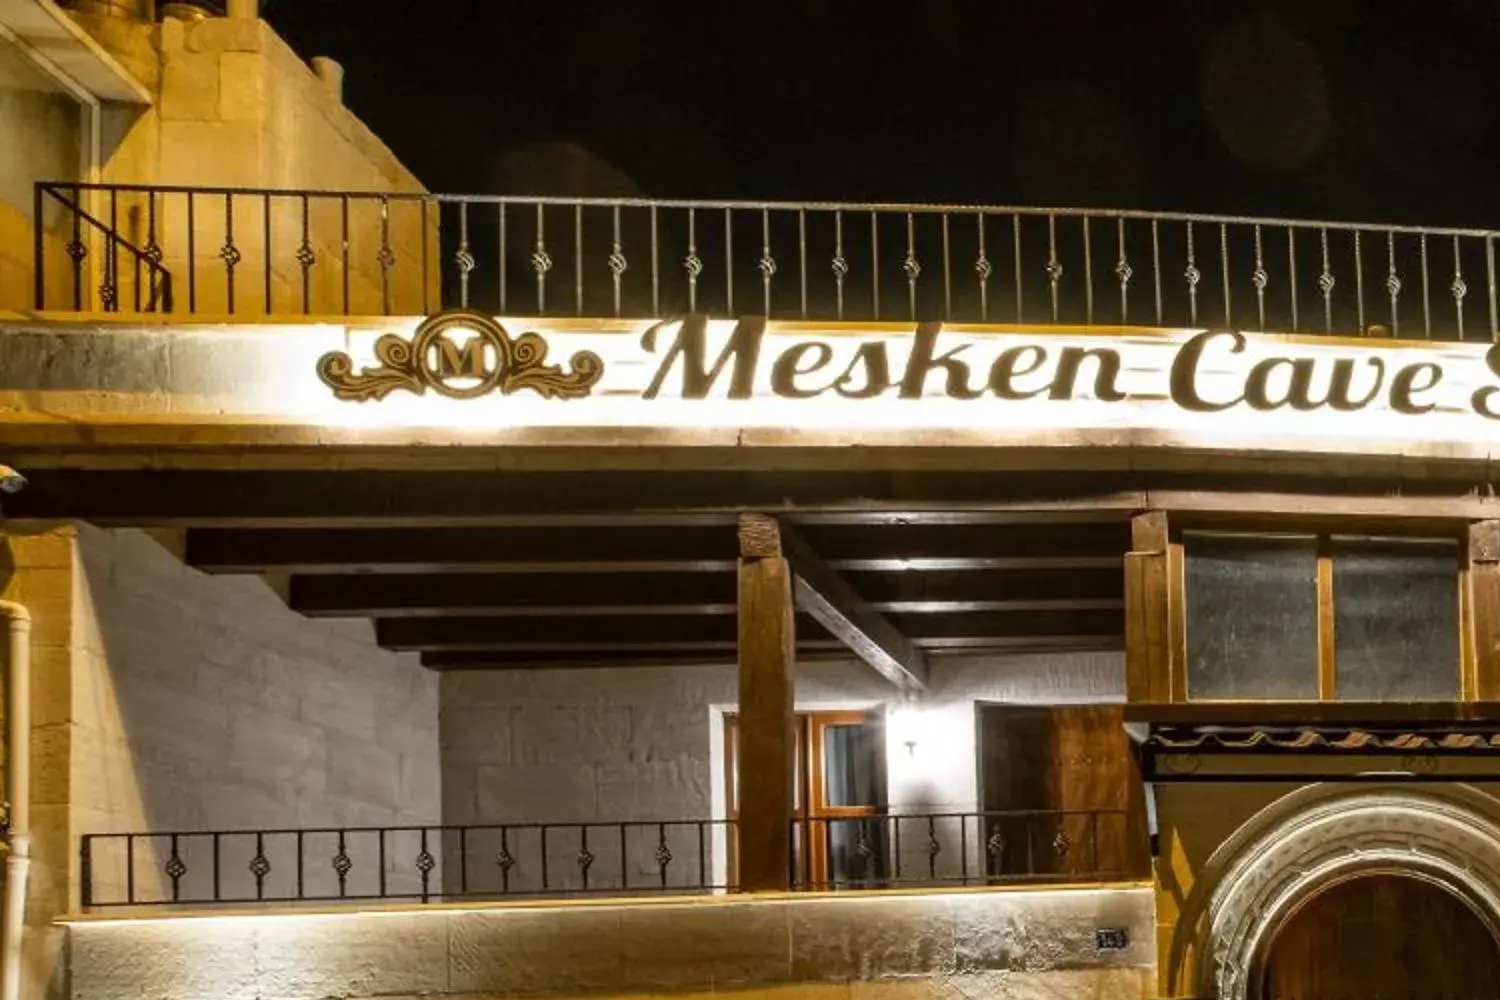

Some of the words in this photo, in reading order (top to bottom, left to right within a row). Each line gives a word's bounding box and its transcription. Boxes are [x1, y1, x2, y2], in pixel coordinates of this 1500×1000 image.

[433, 336, 491, 379] M
[639, 313, 1128, 402] Mesken
[1169, 328, 1444, 415] Cave
